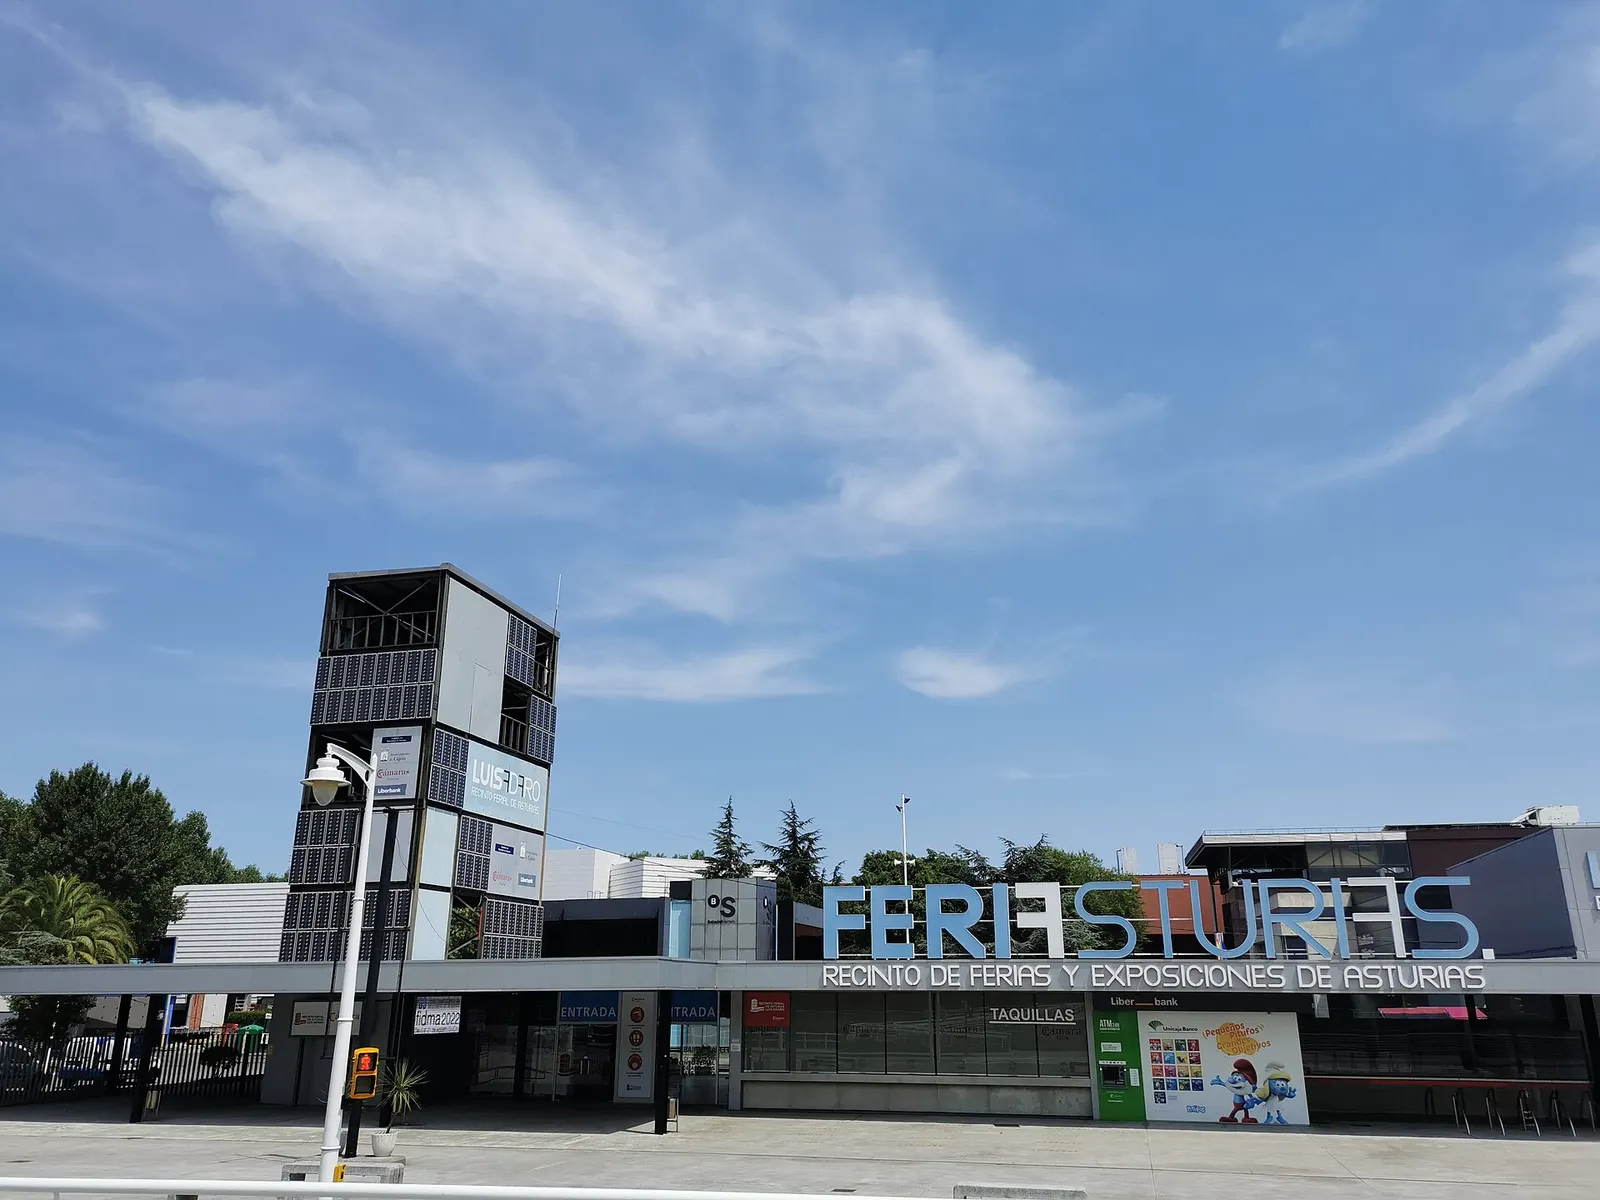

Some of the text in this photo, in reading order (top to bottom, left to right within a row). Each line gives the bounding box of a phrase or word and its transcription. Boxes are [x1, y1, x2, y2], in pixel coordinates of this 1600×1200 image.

[822, 965, 1487, 989] RECINTO DE FERIAS Y EXPOSICIONES DE ASTURIAS
[561, 1006, 617, 1018] ENTRADA
[989, 1008, 1075, 1022] TAQUILLAS
[1229, 1026, 1260, 1039] Pitufos
